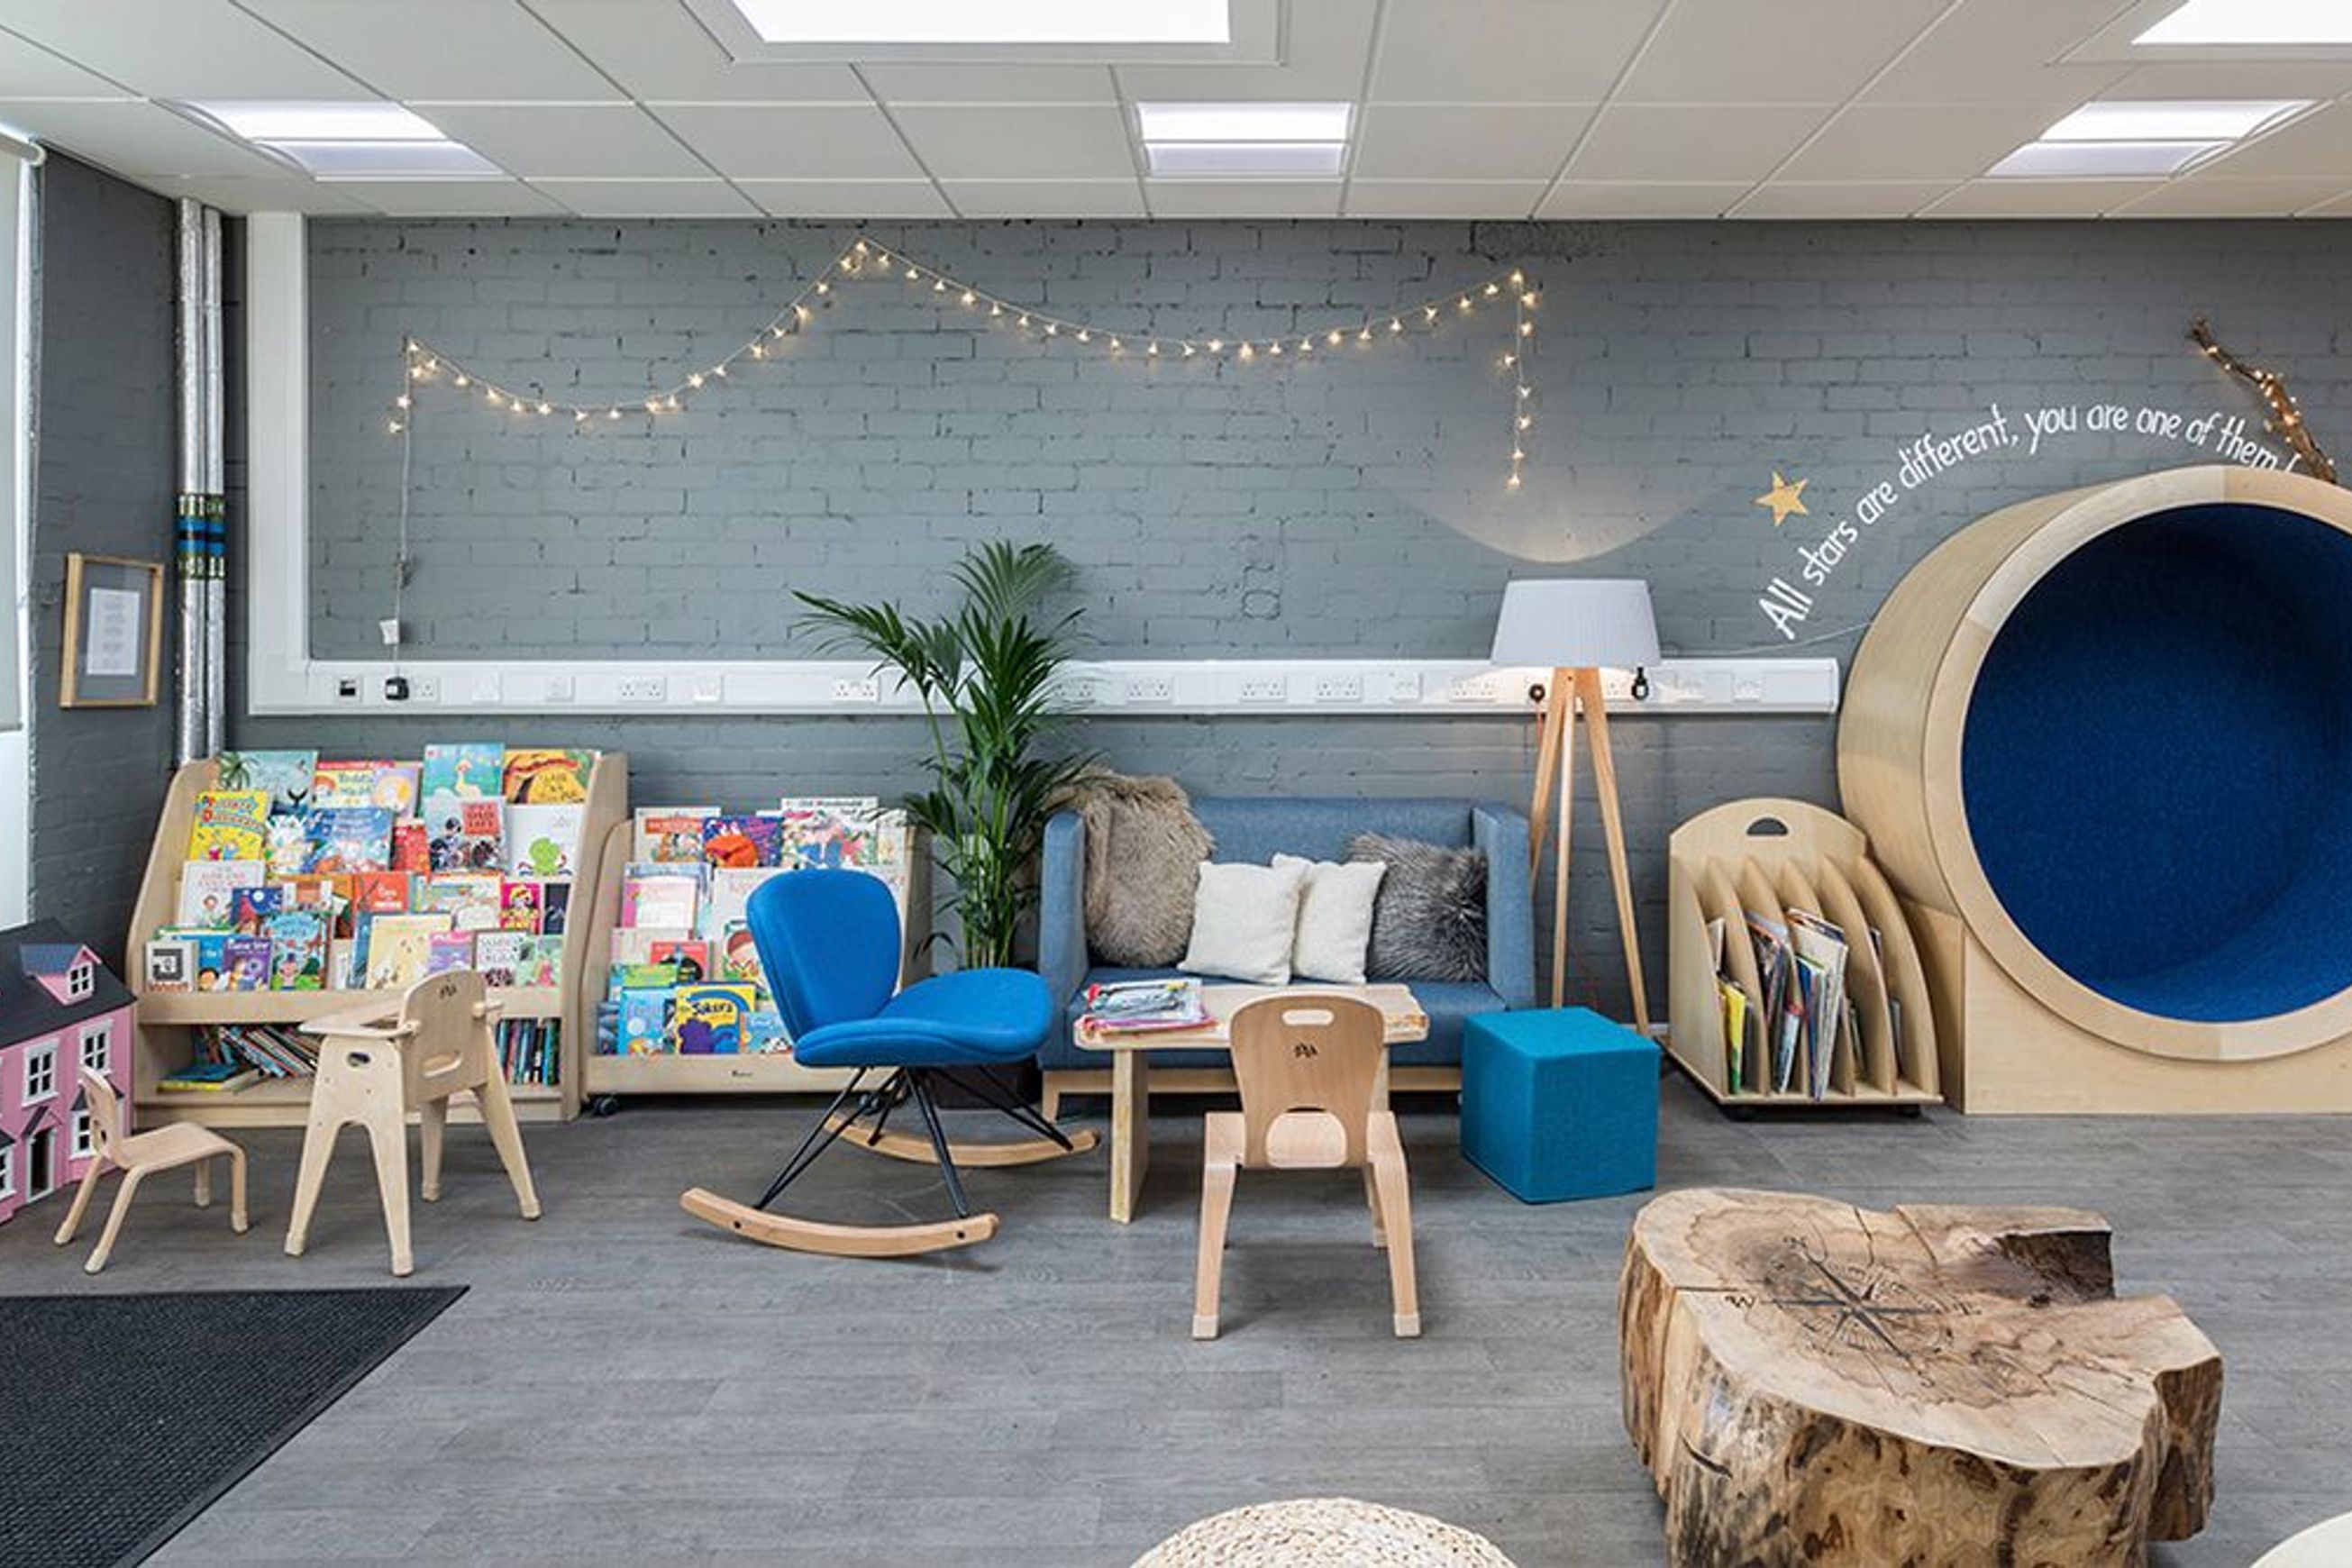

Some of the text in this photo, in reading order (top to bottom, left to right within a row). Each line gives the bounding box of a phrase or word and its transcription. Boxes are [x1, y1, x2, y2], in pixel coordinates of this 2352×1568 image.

[1758, 577, 1813, 640] All
[1798, 521, 1858, 586] stars
[1856, 481, 1898, 524] are
[1899, 403, 2019, 488] different,
[2024, 406, 2076, 454] you
[2086, 405, 2129, 431] are
[2136, 407, 2182, 438] one
[2185, 412, 2222, 445] of
